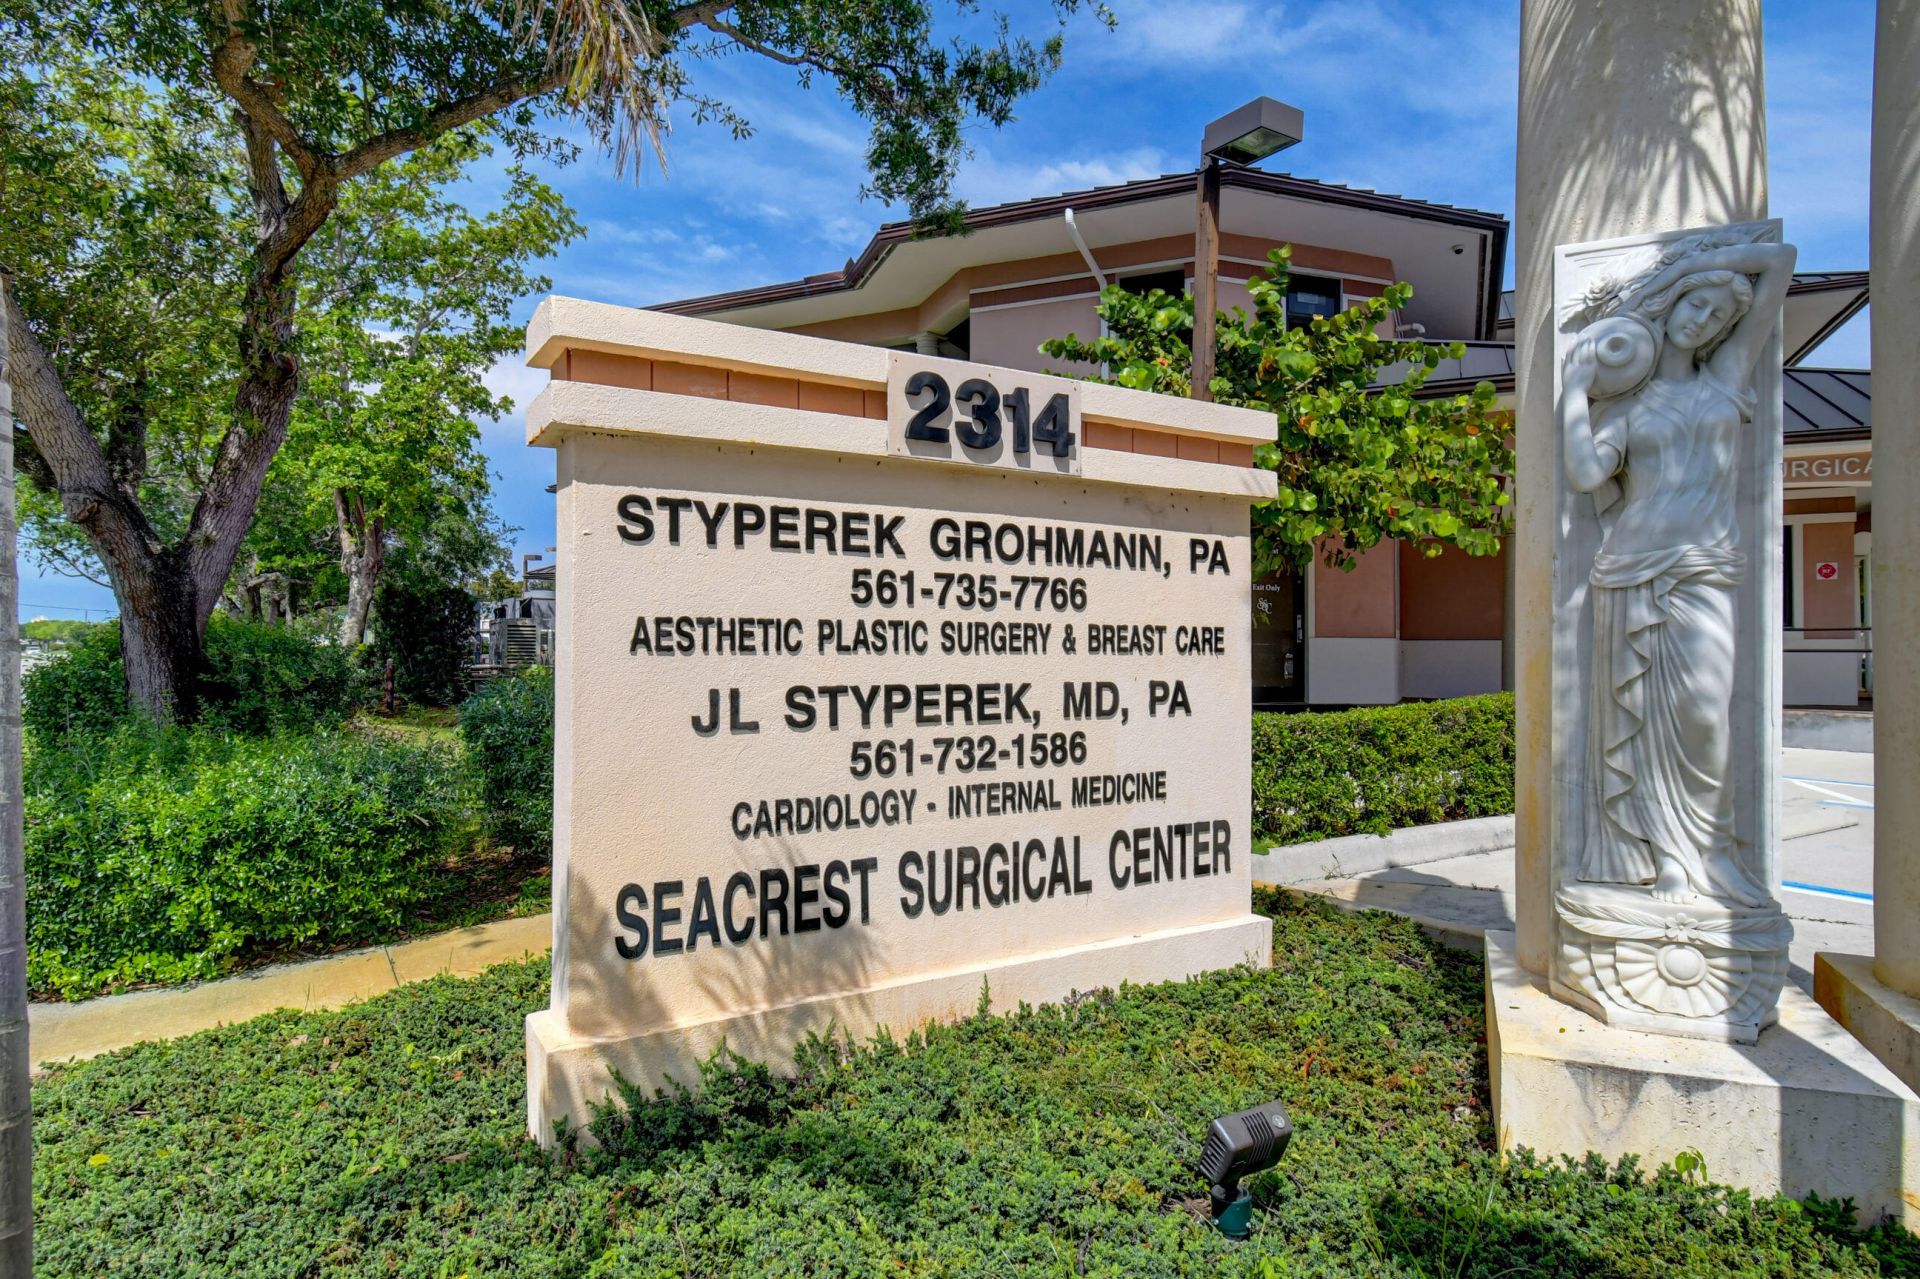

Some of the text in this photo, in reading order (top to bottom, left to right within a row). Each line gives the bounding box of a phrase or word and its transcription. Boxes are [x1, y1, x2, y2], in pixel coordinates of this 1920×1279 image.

[904, 370, 1076, 460] 2314
[617, 494, 1231, 578] STYPEREK GROHMANN, PA
[851, 568, 1088, 611] 561-735-7766
[630, 616, 1226, 656] AESTHETIC PLASTIC SURGERY & BREAST CARE
[691, 680, 1193, 736] JL STYPEREK, MD, PA
[850, 731, 1088, 778] 561-732-1586
[731, 788, 917, 840] CARDIOLOGY
[947, 778, 1062, 820] INTERNAL
[1072, 771, 1168, 810] MEDICINE
[614, 819, 1232, 960] SEACREST SURGICAL CENTER
